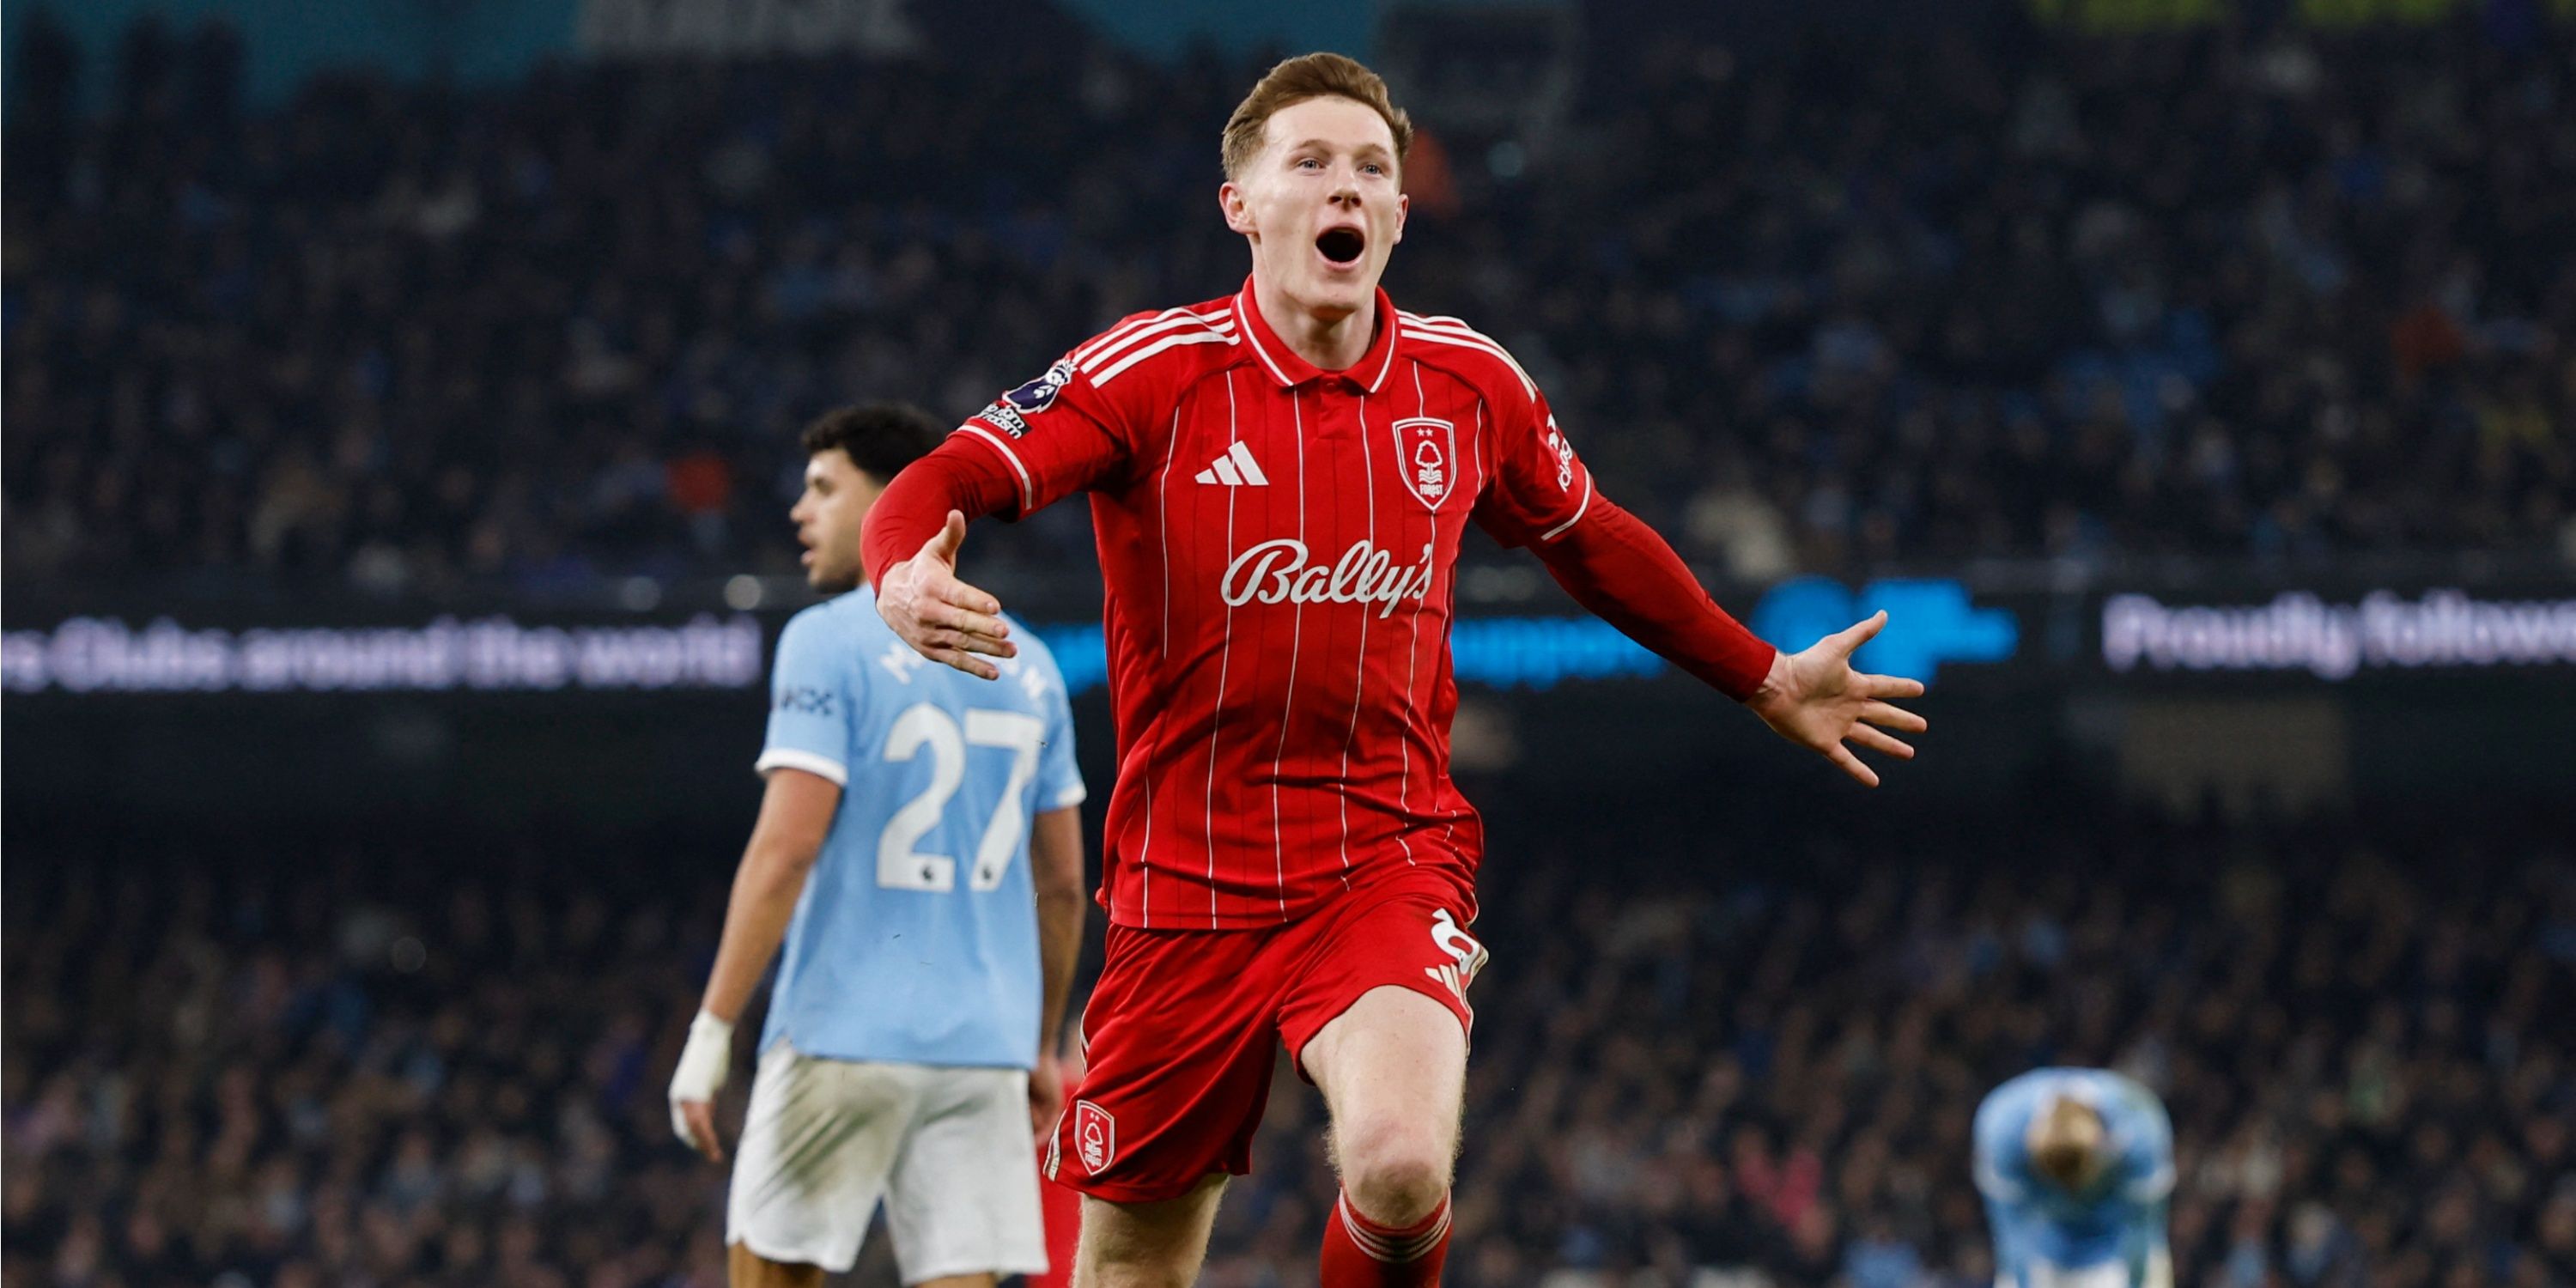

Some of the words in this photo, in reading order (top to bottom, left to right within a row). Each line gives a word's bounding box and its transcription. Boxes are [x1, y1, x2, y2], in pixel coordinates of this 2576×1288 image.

[1220, 538, 1433, 619] Bally's
[52, 617, 232, 690] Clubs
[237, 615, 463, 690] around
[465, 613, 568, 690] the
[574, 611, 761, 689] world
[2103, 594, 2360, 679] Proudly
[877, 702, 1045, 892] 27
